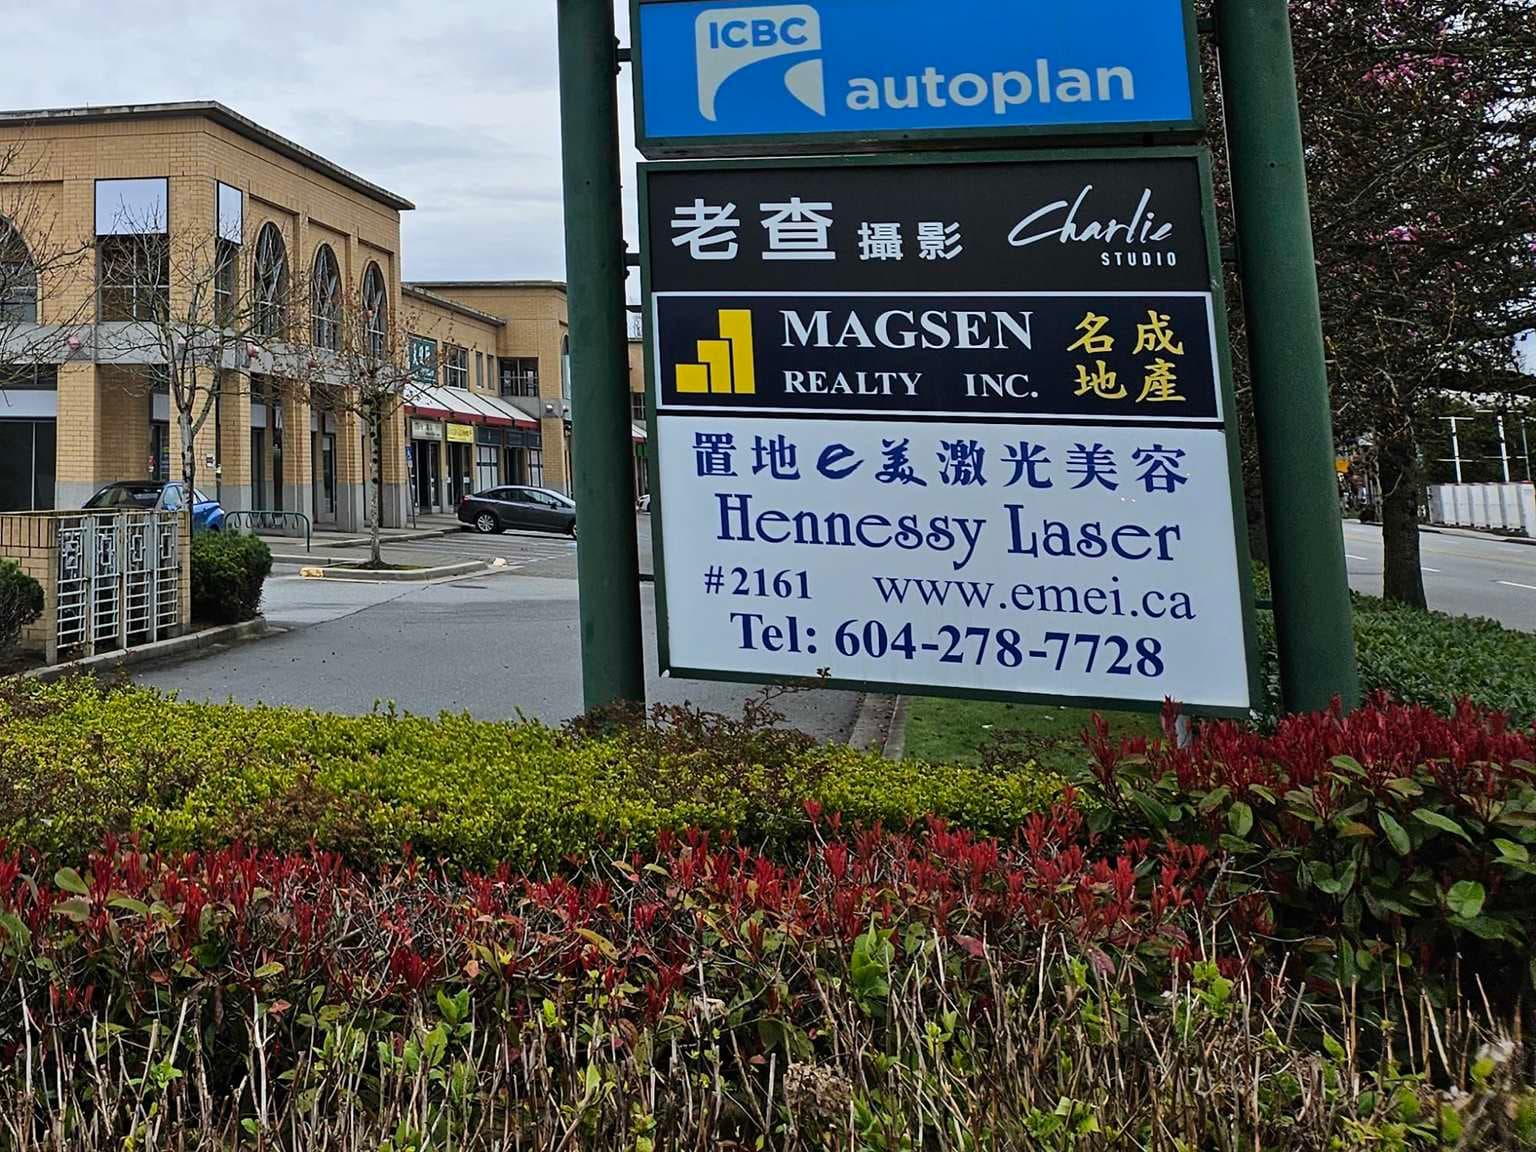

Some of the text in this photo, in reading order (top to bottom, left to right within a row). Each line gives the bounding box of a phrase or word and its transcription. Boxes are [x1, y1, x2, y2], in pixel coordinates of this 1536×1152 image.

[708, 16, 808, 49] ICBC
[846, 58, 1135, 115] autoplan
[1007, 184, 1173, 247] Charlie
[1100, 251, 1177, 267] STUDIO
[780, 309, 1034, 350] MAGSEN
[1066, 310, 1185, 356] 名成
[783, 370, 1039, 398] REALTY INC.
[1073, 359, 1187, 404] 地產
[714, 493, 1181, 570] Hennessy Laser
[704, 565, 1197, 621] #2161 www.emei.ca
[730, 612, 1166, 678] Tel: 604-278-7728
